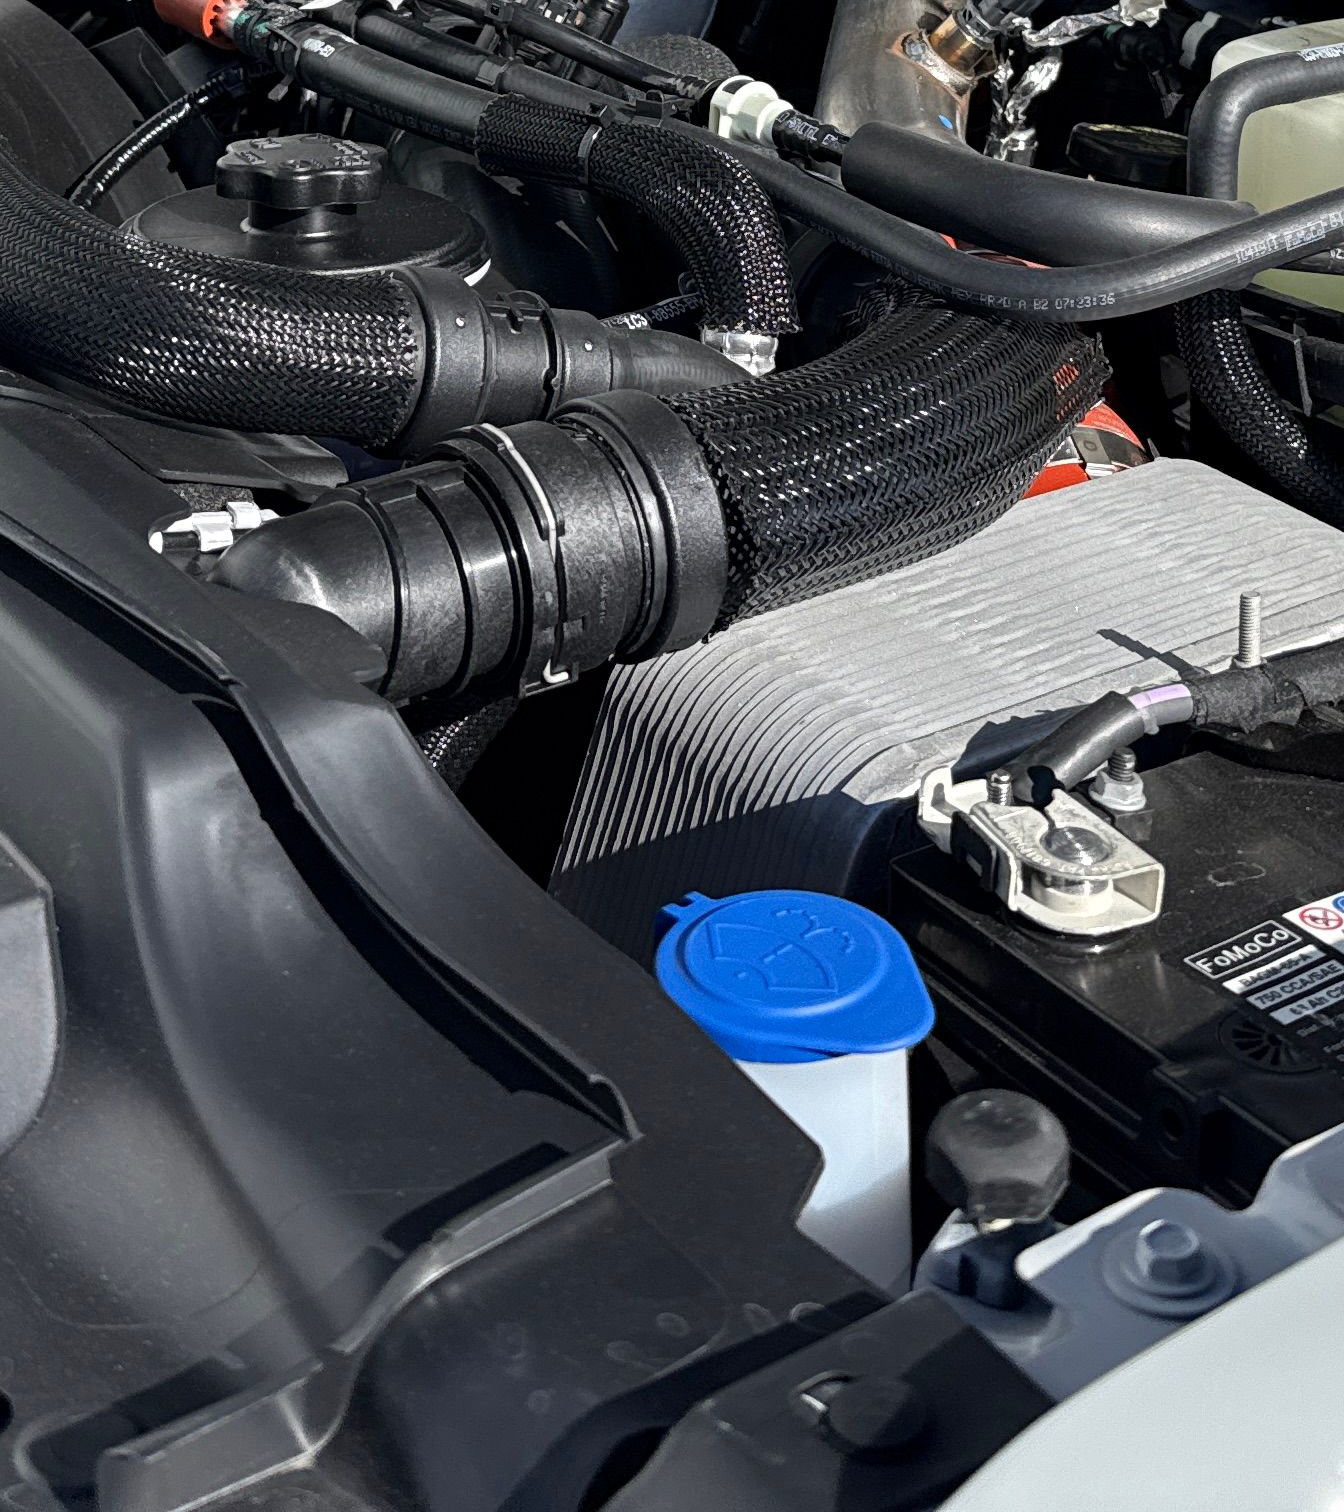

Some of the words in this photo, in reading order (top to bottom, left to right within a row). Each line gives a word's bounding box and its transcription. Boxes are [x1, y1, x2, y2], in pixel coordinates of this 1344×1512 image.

[1195, 928, 1290, 974] FoMoCo
[1254, 991, 1282, 1005] 750
[1280, 963, 1342, 994] CCA/SAE
